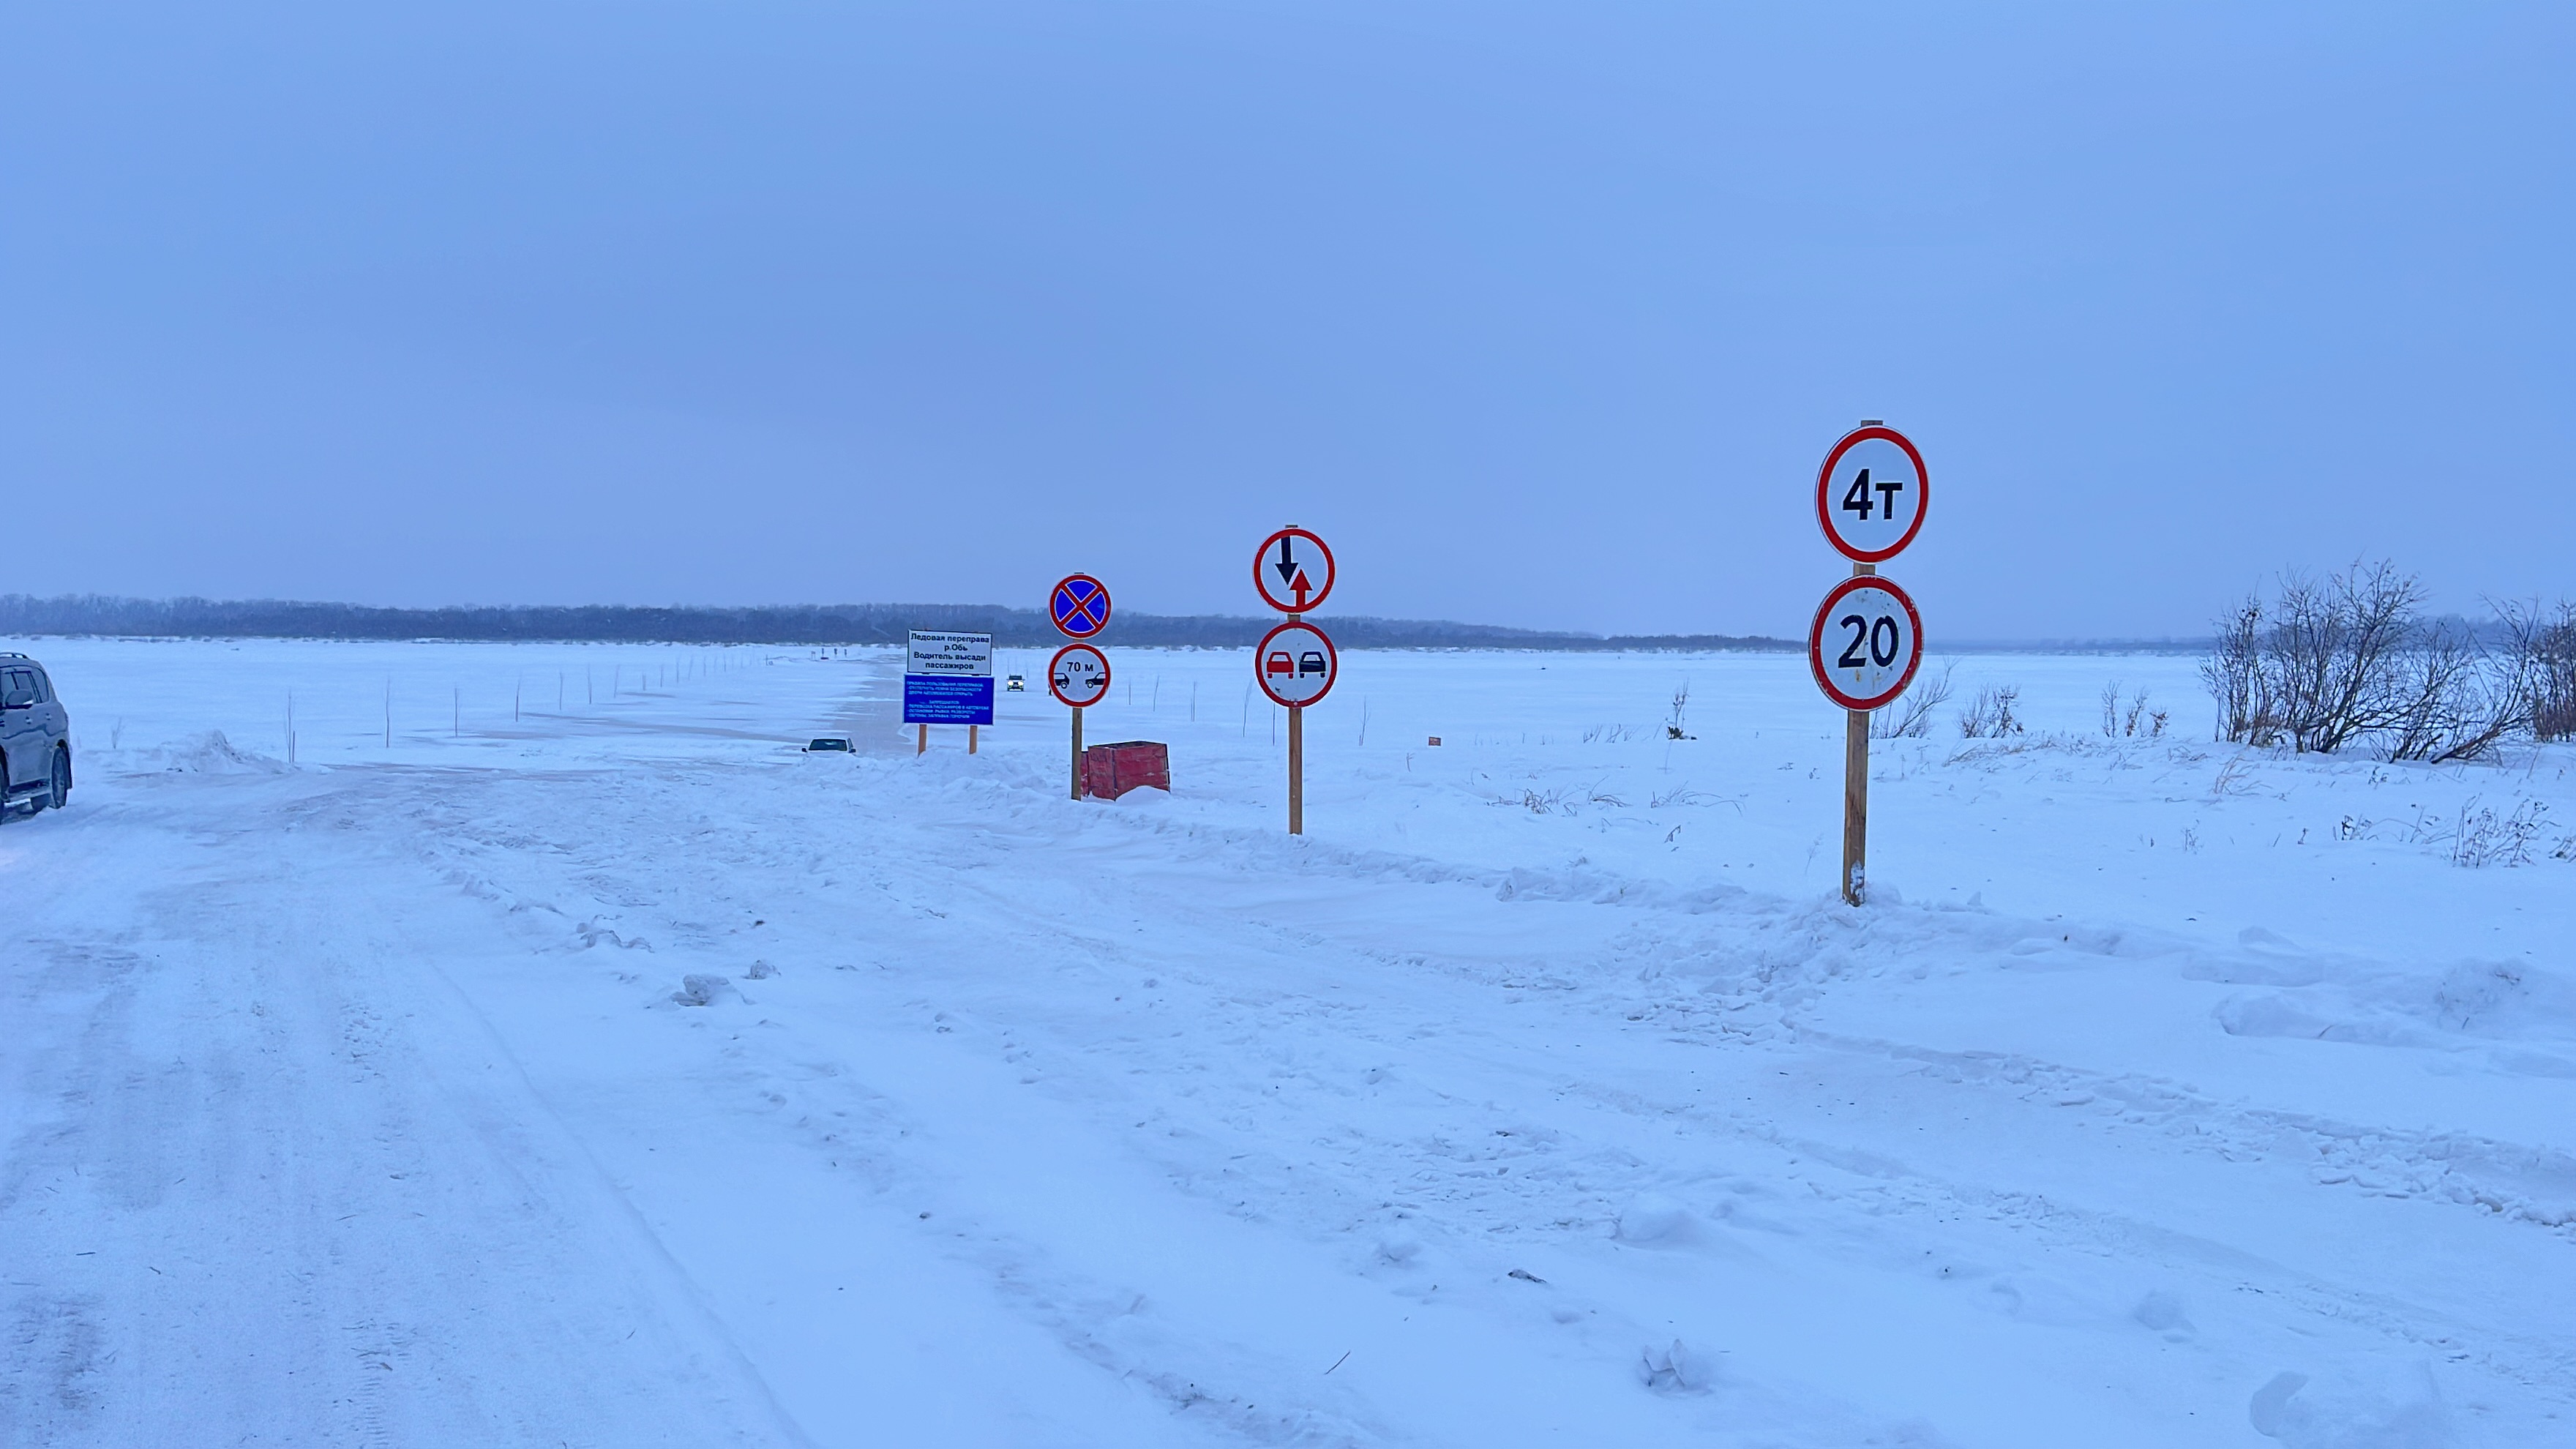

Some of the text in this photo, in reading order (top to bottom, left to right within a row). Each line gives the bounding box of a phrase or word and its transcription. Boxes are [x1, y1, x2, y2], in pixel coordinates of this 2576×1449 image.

[1842, 468, 1903, 520] 4т
[910, 633, 989, 643] Ледовая переправа
[1838, 614, 1899, 668] 20
[914, 651, 953, 660] Водитель
[925, 662, 974, 670] пассажиров
[1067, 662, 1093, 672] 70 м
